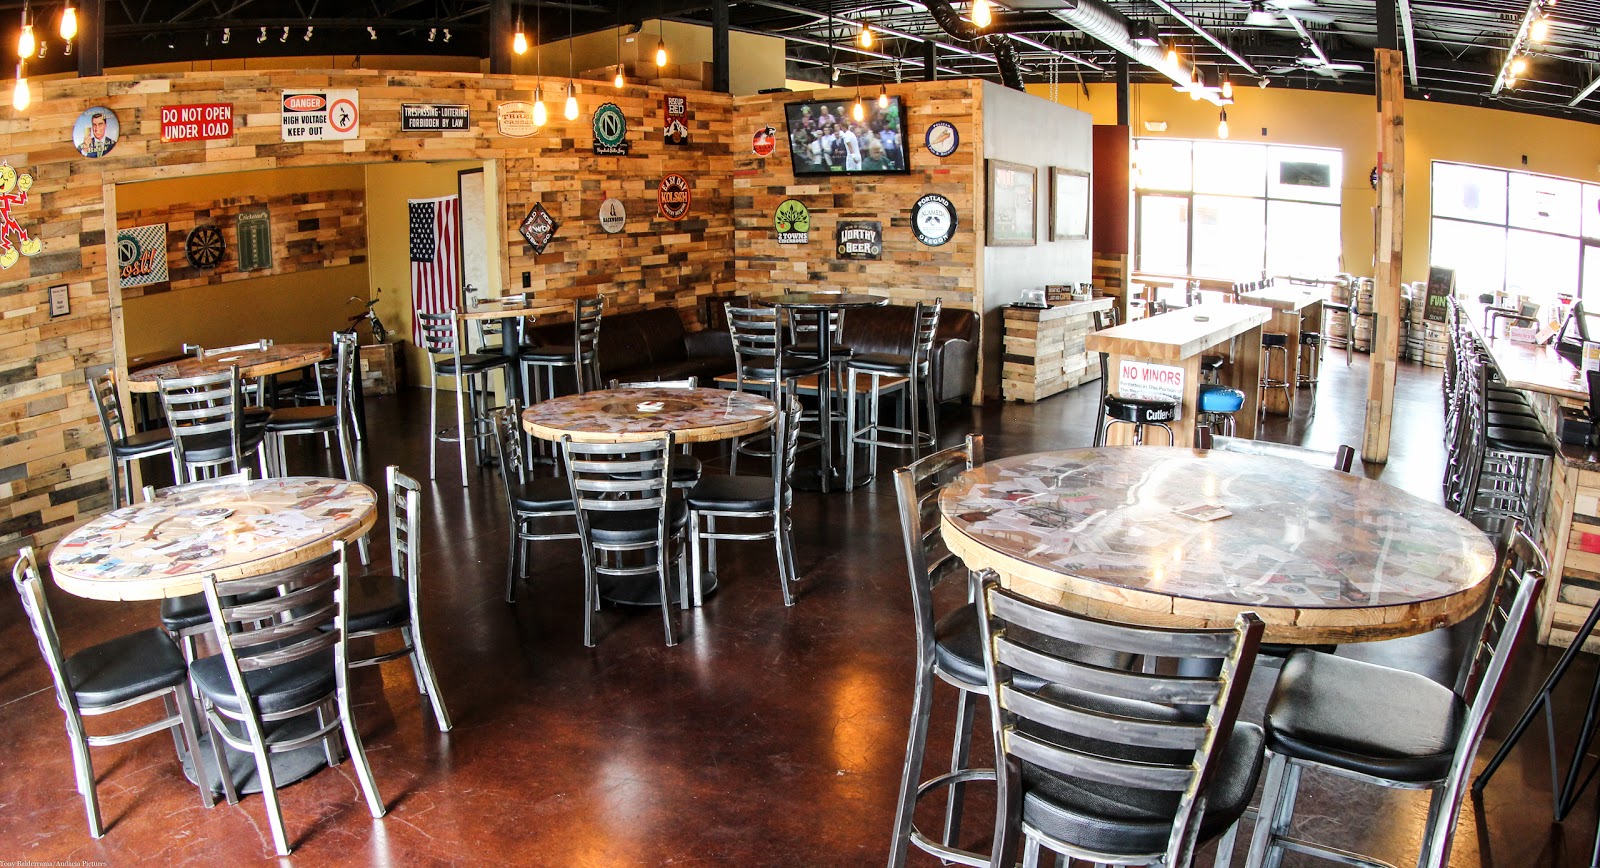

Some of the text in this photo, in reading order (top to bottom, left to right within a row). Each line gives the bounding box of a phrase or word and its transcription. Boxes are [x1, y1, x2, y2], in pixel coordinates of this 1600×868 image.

[290, 98, 321, 108] DANGER
[162, 106, 231, 123] DO NOT OPEN
[668, 105, 684, 114] RED
[283, 115, 326, 124] HIGH VOLTAGE
[409, 118, 464, 128] FORBIDDEN BY LAW
[165, 123, 229, 140] UNDER LOAD
[288, 126, 323, 136] KEEP OUT
[662, 176, 688, 192] EASY DAY
[917, 195, 949, 207] PORTLAND
[841, 229, 876, 244] WORTHY
[919, 234, 949, 245] OREGON
[846, 242, 871, 254] BEER
[1123, 366, 1181, 385] NO MINORS
